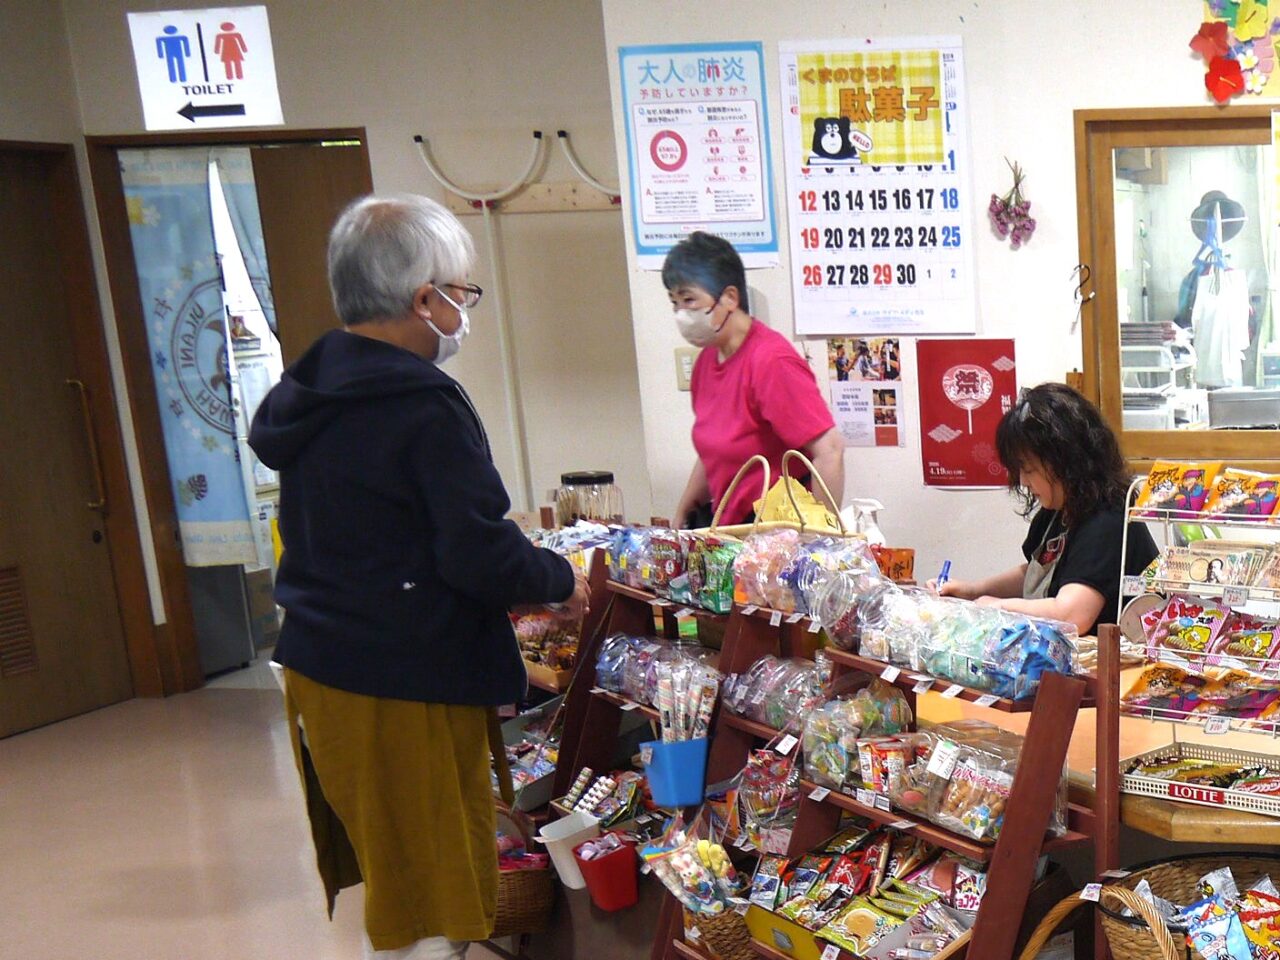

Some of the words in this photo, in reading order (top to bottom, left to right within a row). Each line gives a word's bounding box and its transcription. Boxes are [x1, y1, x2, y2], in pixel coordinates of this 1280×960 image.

[638, 56, 746, 85] 大人の肺炎
[802, 64, 897, 85] くまのひろば
[182, 84, 235, 95] TOILET
[839, 86, 940, 123] 駄菓子
[799, 190, 817, 211] 12
[823, 190, 840, 211] 13
[846, 190, 863, 211] 14
[869, 189, 887, 210] 15
[893, 189, 911, 210] 16
[917, 188, 934, 209] 17
[940, 188, 958, 209] 18
[801, 228, 819, 249] 19
[824, 228, 842, 249] 20
[848, 227, 865, 248] 21
[871, 227, 890, 248] 22
[895, 226, 913, 247] 23
[919, 226, 937, 247] 24
[942, 226, 961, 247] 25
[803, 265, 822, 286] 26
[826, 265, 845, 285] 27
[850, 264, 869, 285] 28
[873, 264, 892, 285] 29
[897, 264, 916, 285] 30
[951, 268, 957, 279] 2
[1174, 786, 1219, 803] LOTTE
